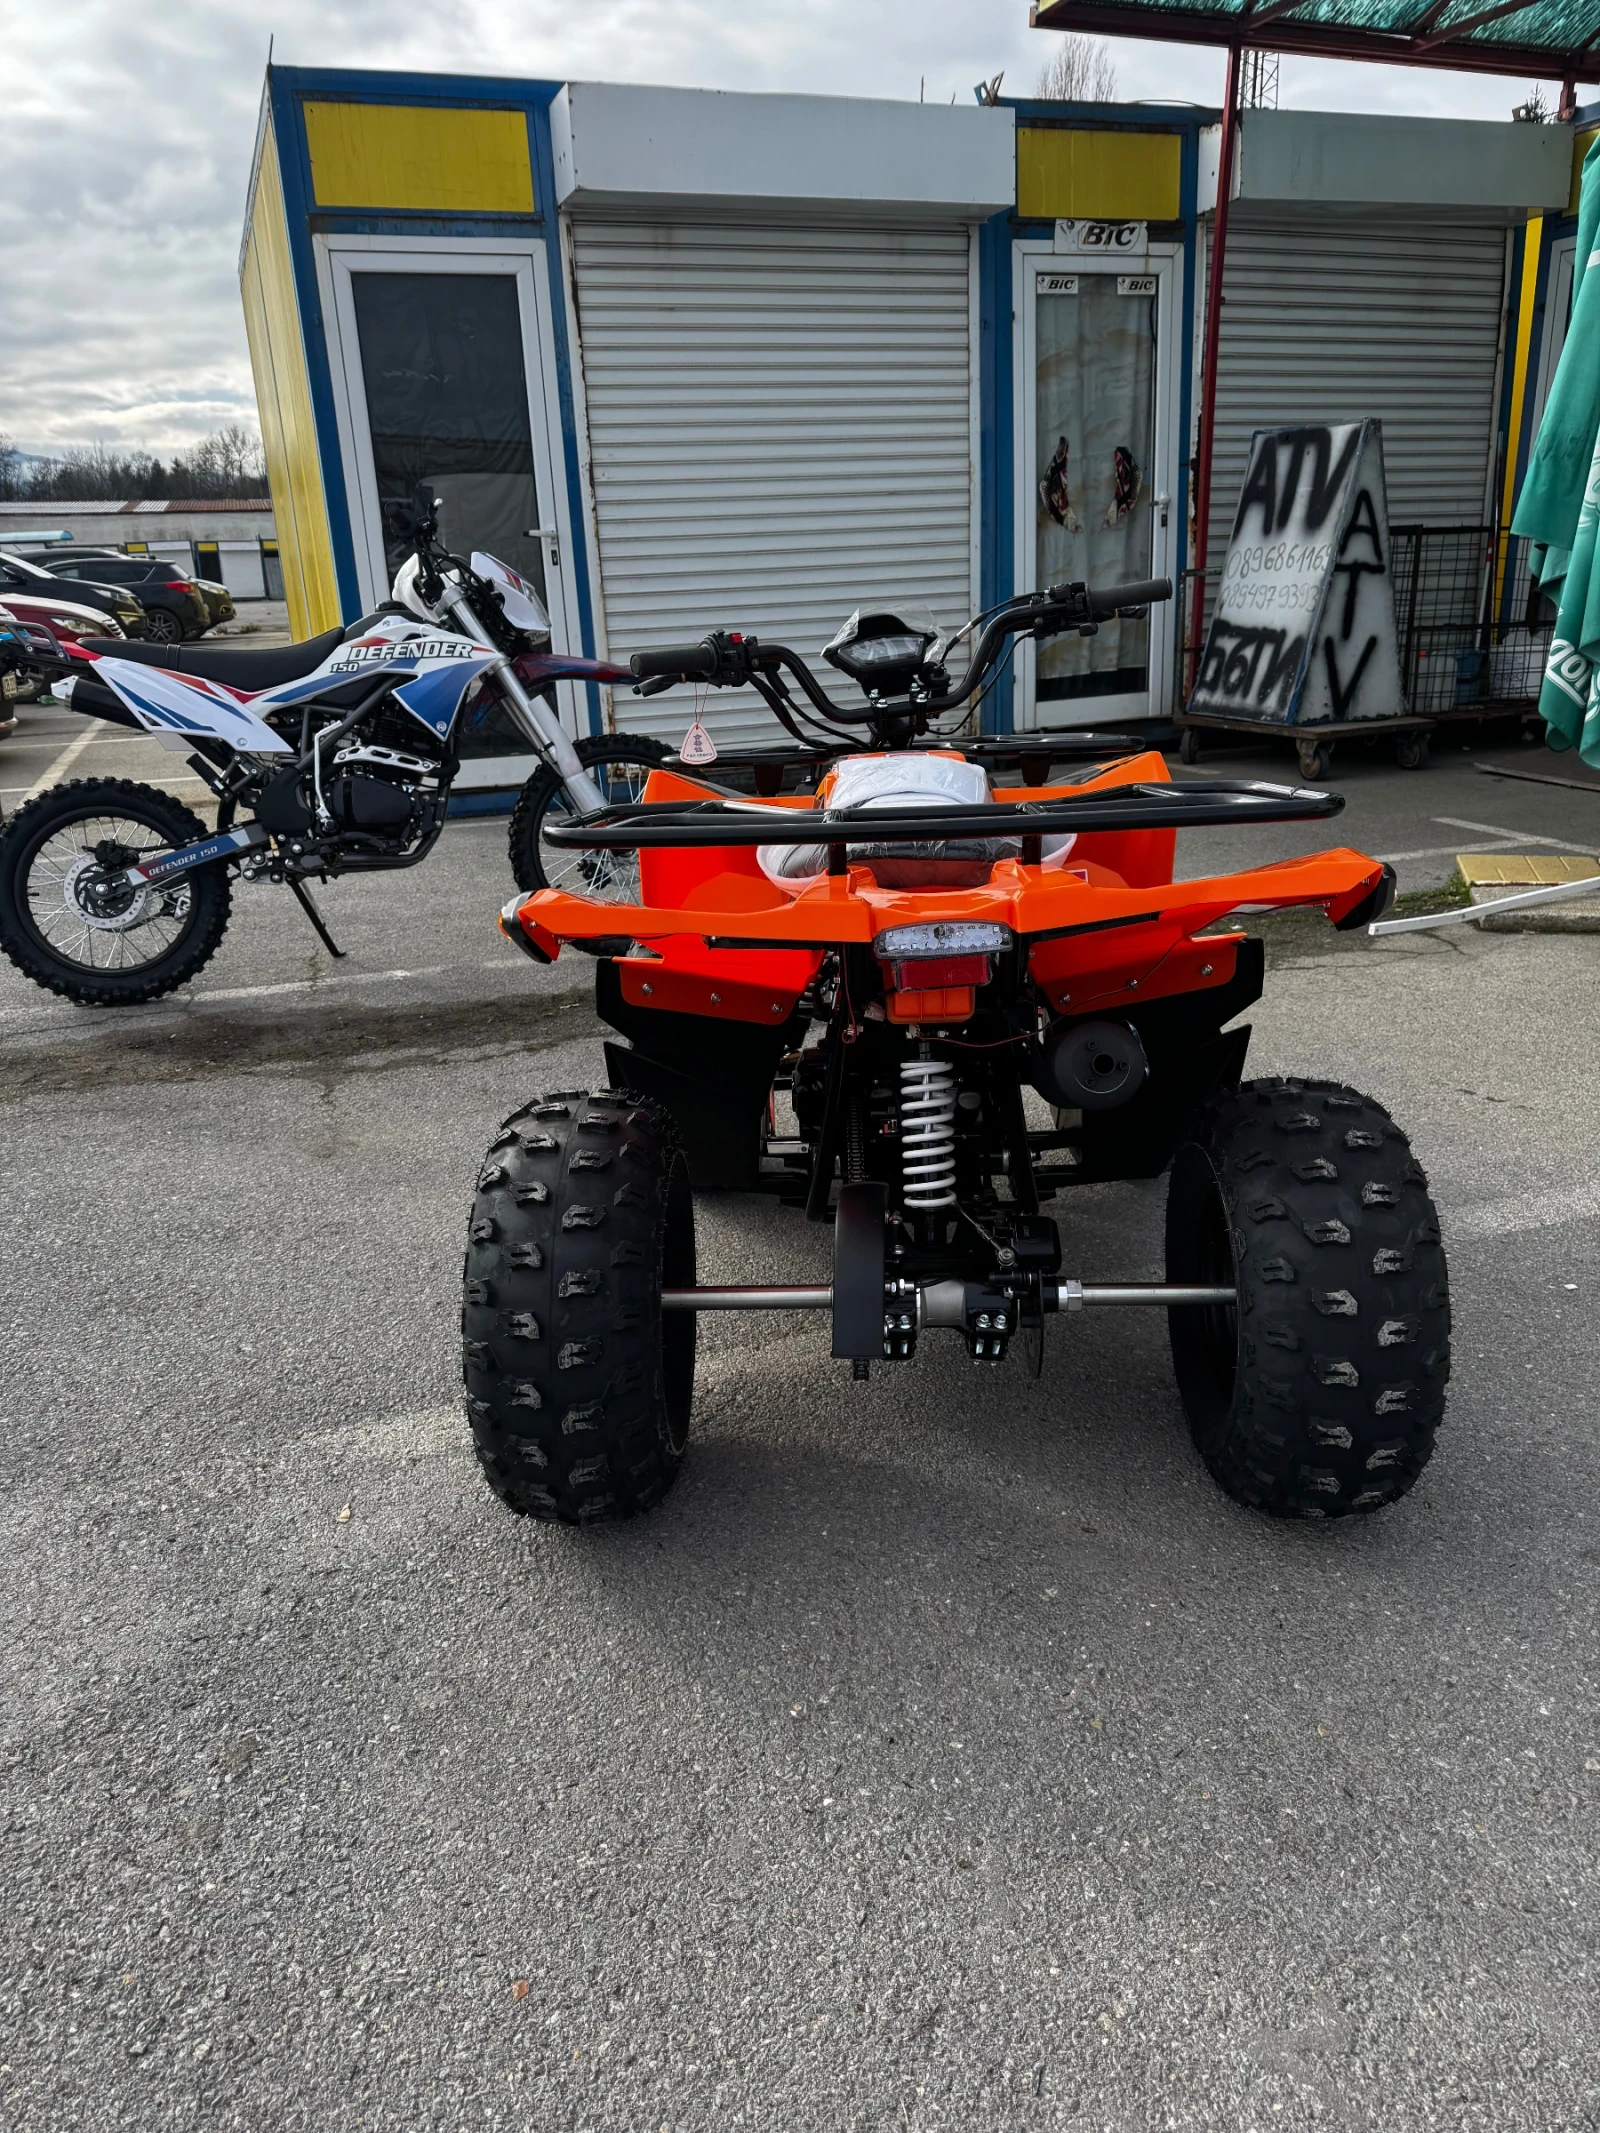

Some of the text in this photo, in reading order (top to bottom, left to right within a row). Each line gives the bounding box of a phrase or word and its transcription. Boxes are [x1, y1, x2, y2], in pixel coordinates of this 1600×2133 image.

[1233, 427, 1362, 540] ATV
[347, 641, 474, 661] DEFENDER
[330, 661, 360, 673] 150
[148, 845, 218, 877] DEFENDER 150
